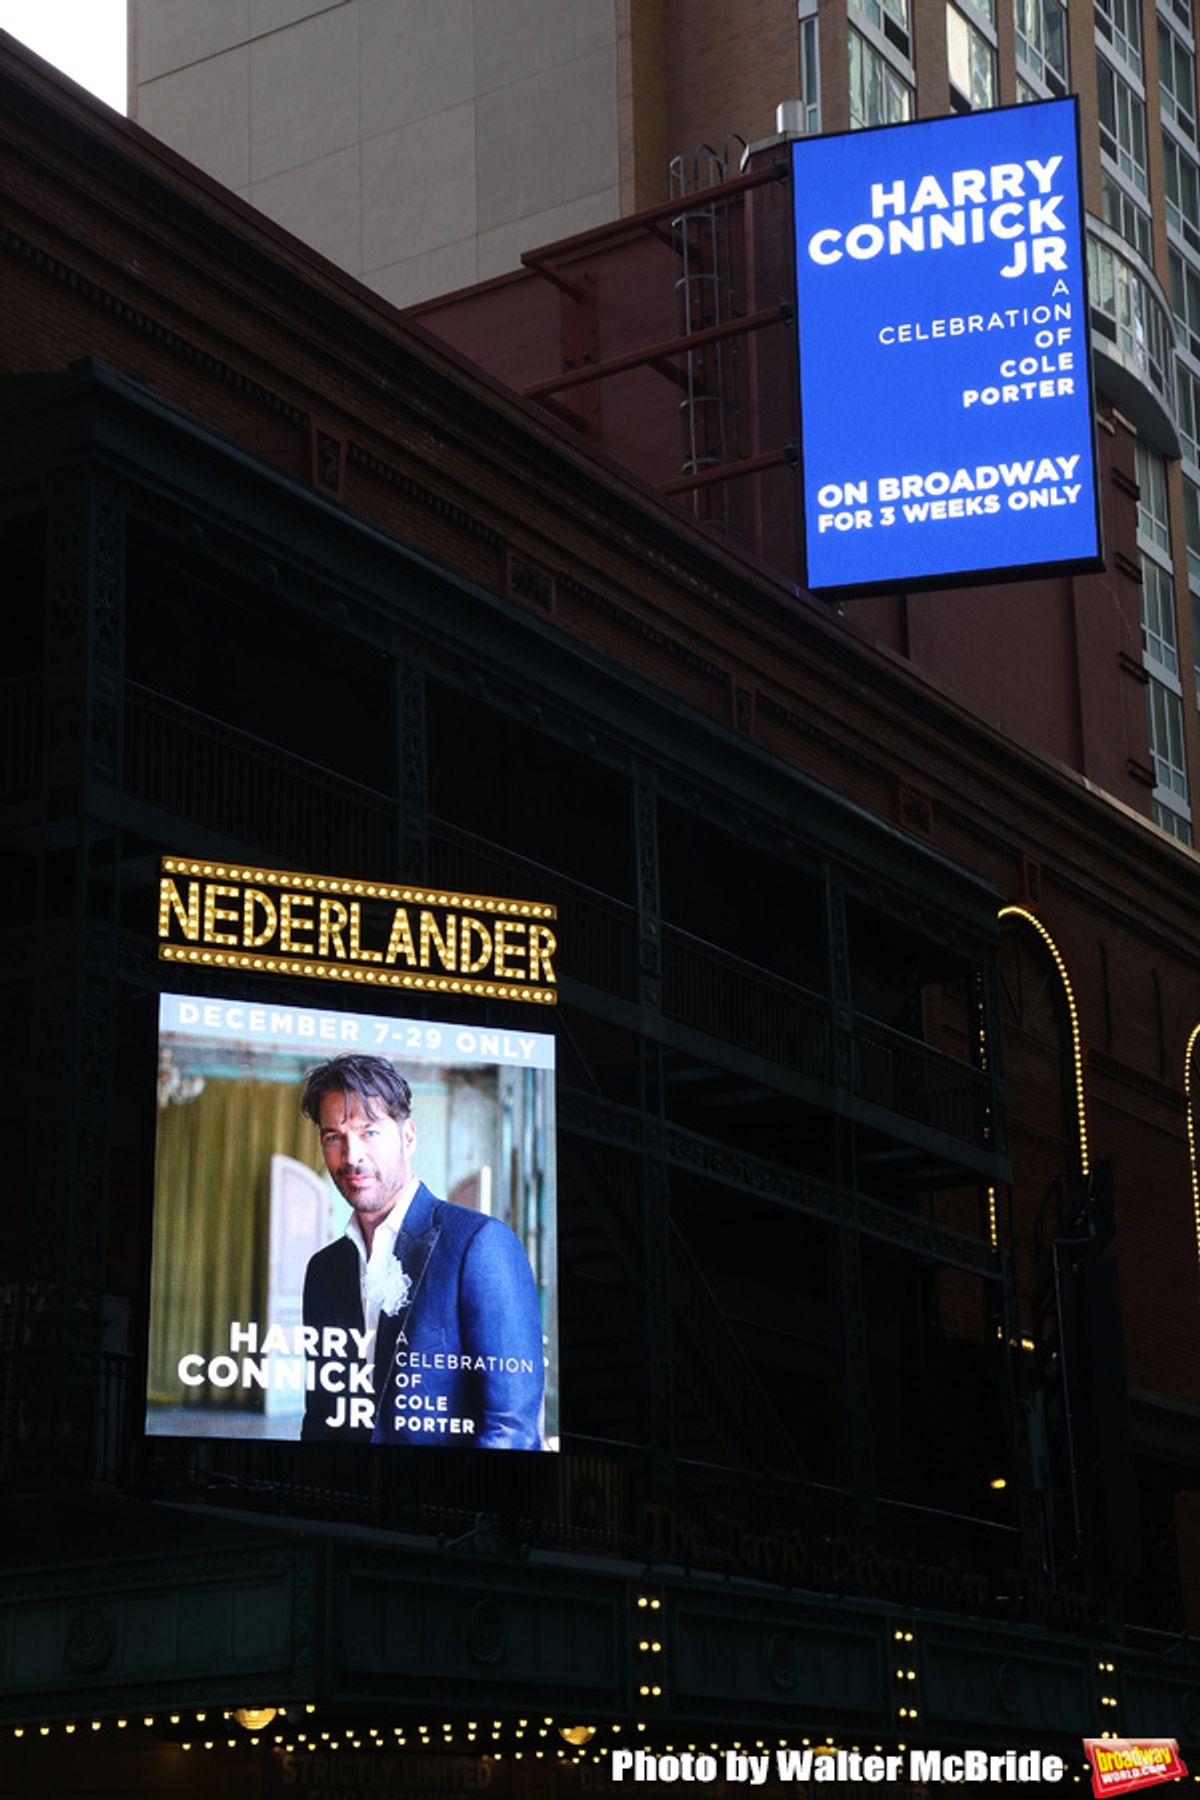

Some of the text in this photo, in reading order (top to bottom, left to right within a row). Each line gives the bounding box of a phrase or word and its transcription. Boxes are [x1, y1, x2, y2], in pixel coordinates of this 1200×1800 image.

[870, 155, 1064, 219] HARRY
[808, 195, 1067, 265] CONNICK
[1000, 236, 1068, 278] JR
[1052, 278, 1070, 297] A
[878, 303, 1072, 345] CELEBRATION
[1034, 327, 1072, 348] OF
[1000, 352, 1073, 378] COLE
[963, 378, 1075, 408] PORTER
[817, 454, 1081, 508] ON BROADWAY
[818, 484, 1082, 533] FOR 3 WEEKS ONLY
[158, 877, 558, 984] NEDERLANDER
[179, 1002, 537, 1060] DECEMBER 7-29 ONLY
[229, 1322, 377, 1360] HARRY
[395, 1332, 409, 1346] A
[177, 1354, 376, 1394] CONNICK
[395, 1351, 535, 1374] CELEBRATION
[395, 1373, 422, 1389] OF
[325, 1397, 377, 1429] JR
[394, 1394, 448, 1412] COLE
[394, 1415, 475, 1434] PORTER
[281, 1753, 493, 1790] STRICTLY LIMITED
